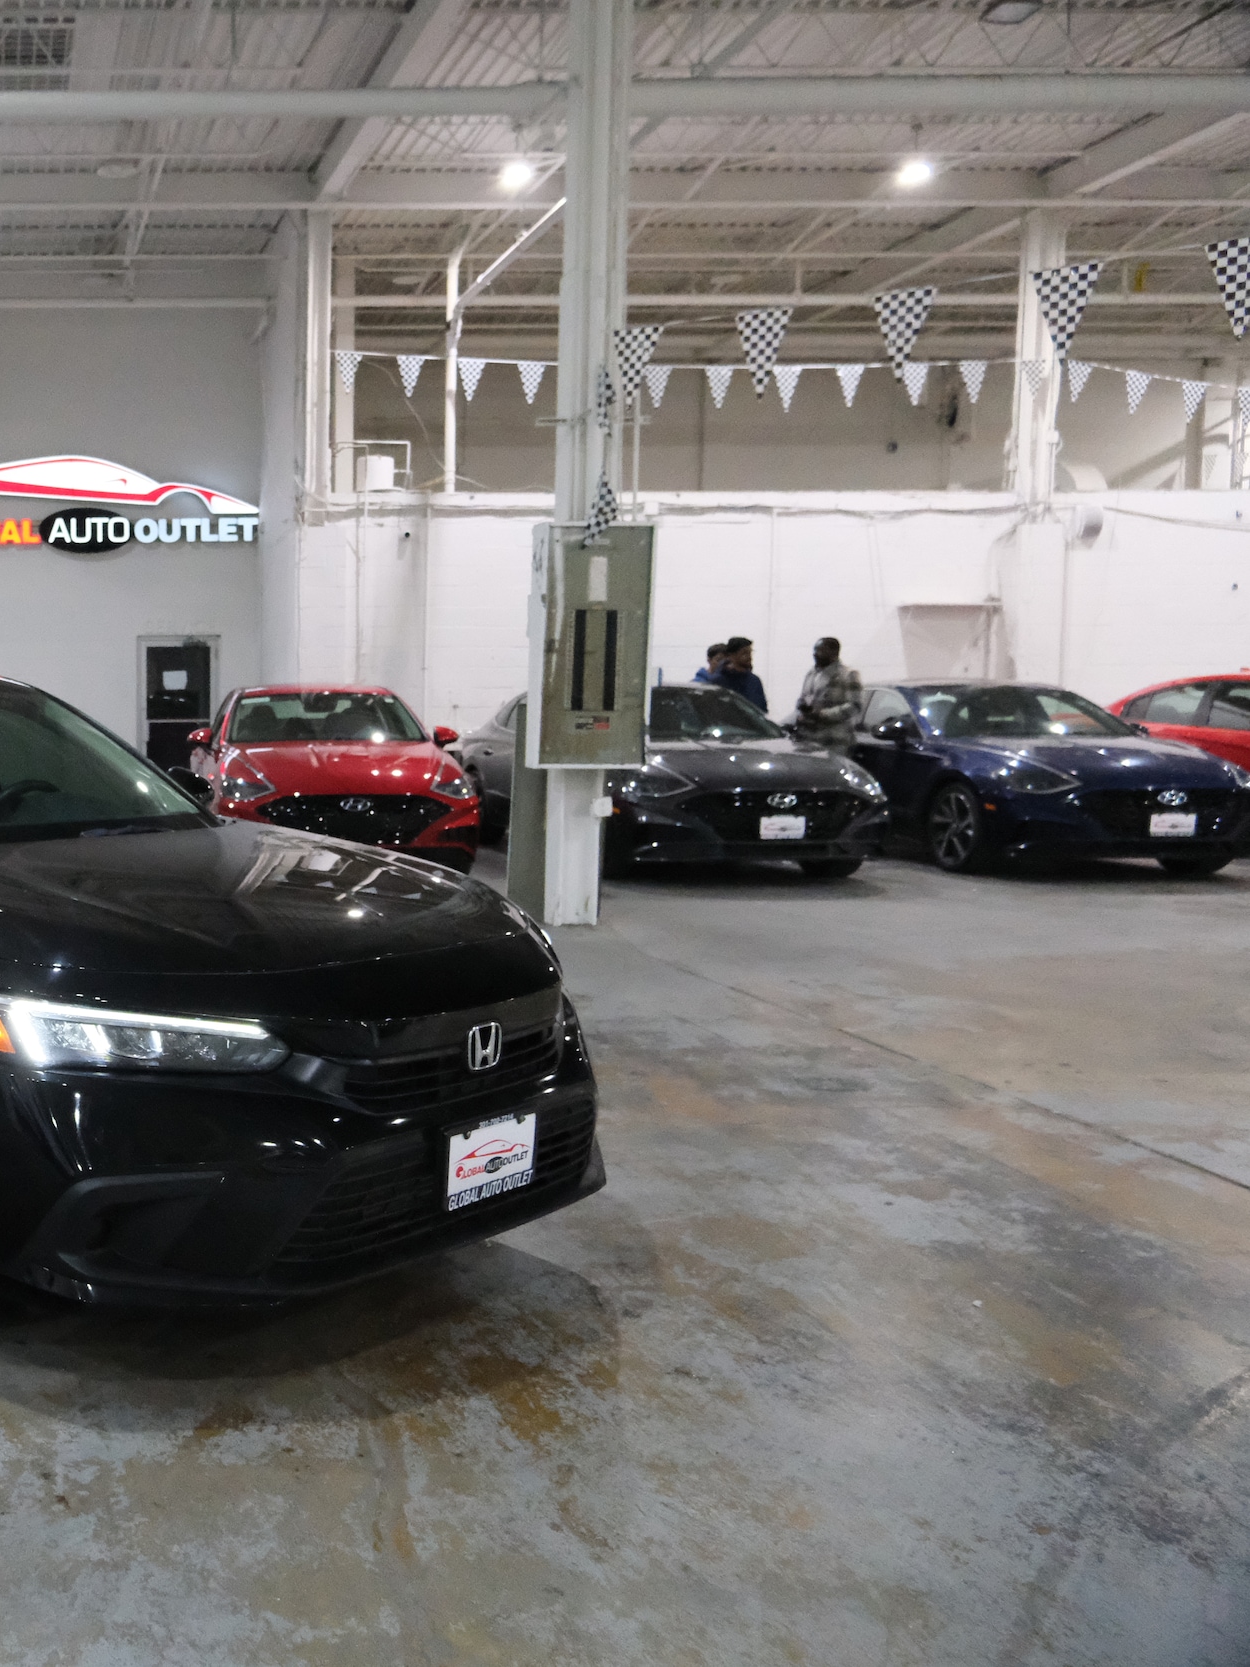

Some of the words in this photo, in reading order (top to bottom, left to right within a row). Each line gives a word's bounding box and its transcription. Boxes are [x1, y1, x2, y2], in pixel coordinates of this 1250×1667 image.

[48, 517, 130, 543] AUTO
[134, 517, 259, 543] OUTLET
[503, 1150, 528, 1166] OUTLET
[448, 1188, 480, 1211] GLOBAL
[480, 1180, 502, 1200] AUTO
[503, 1170, 533, 1192] OUTLET
